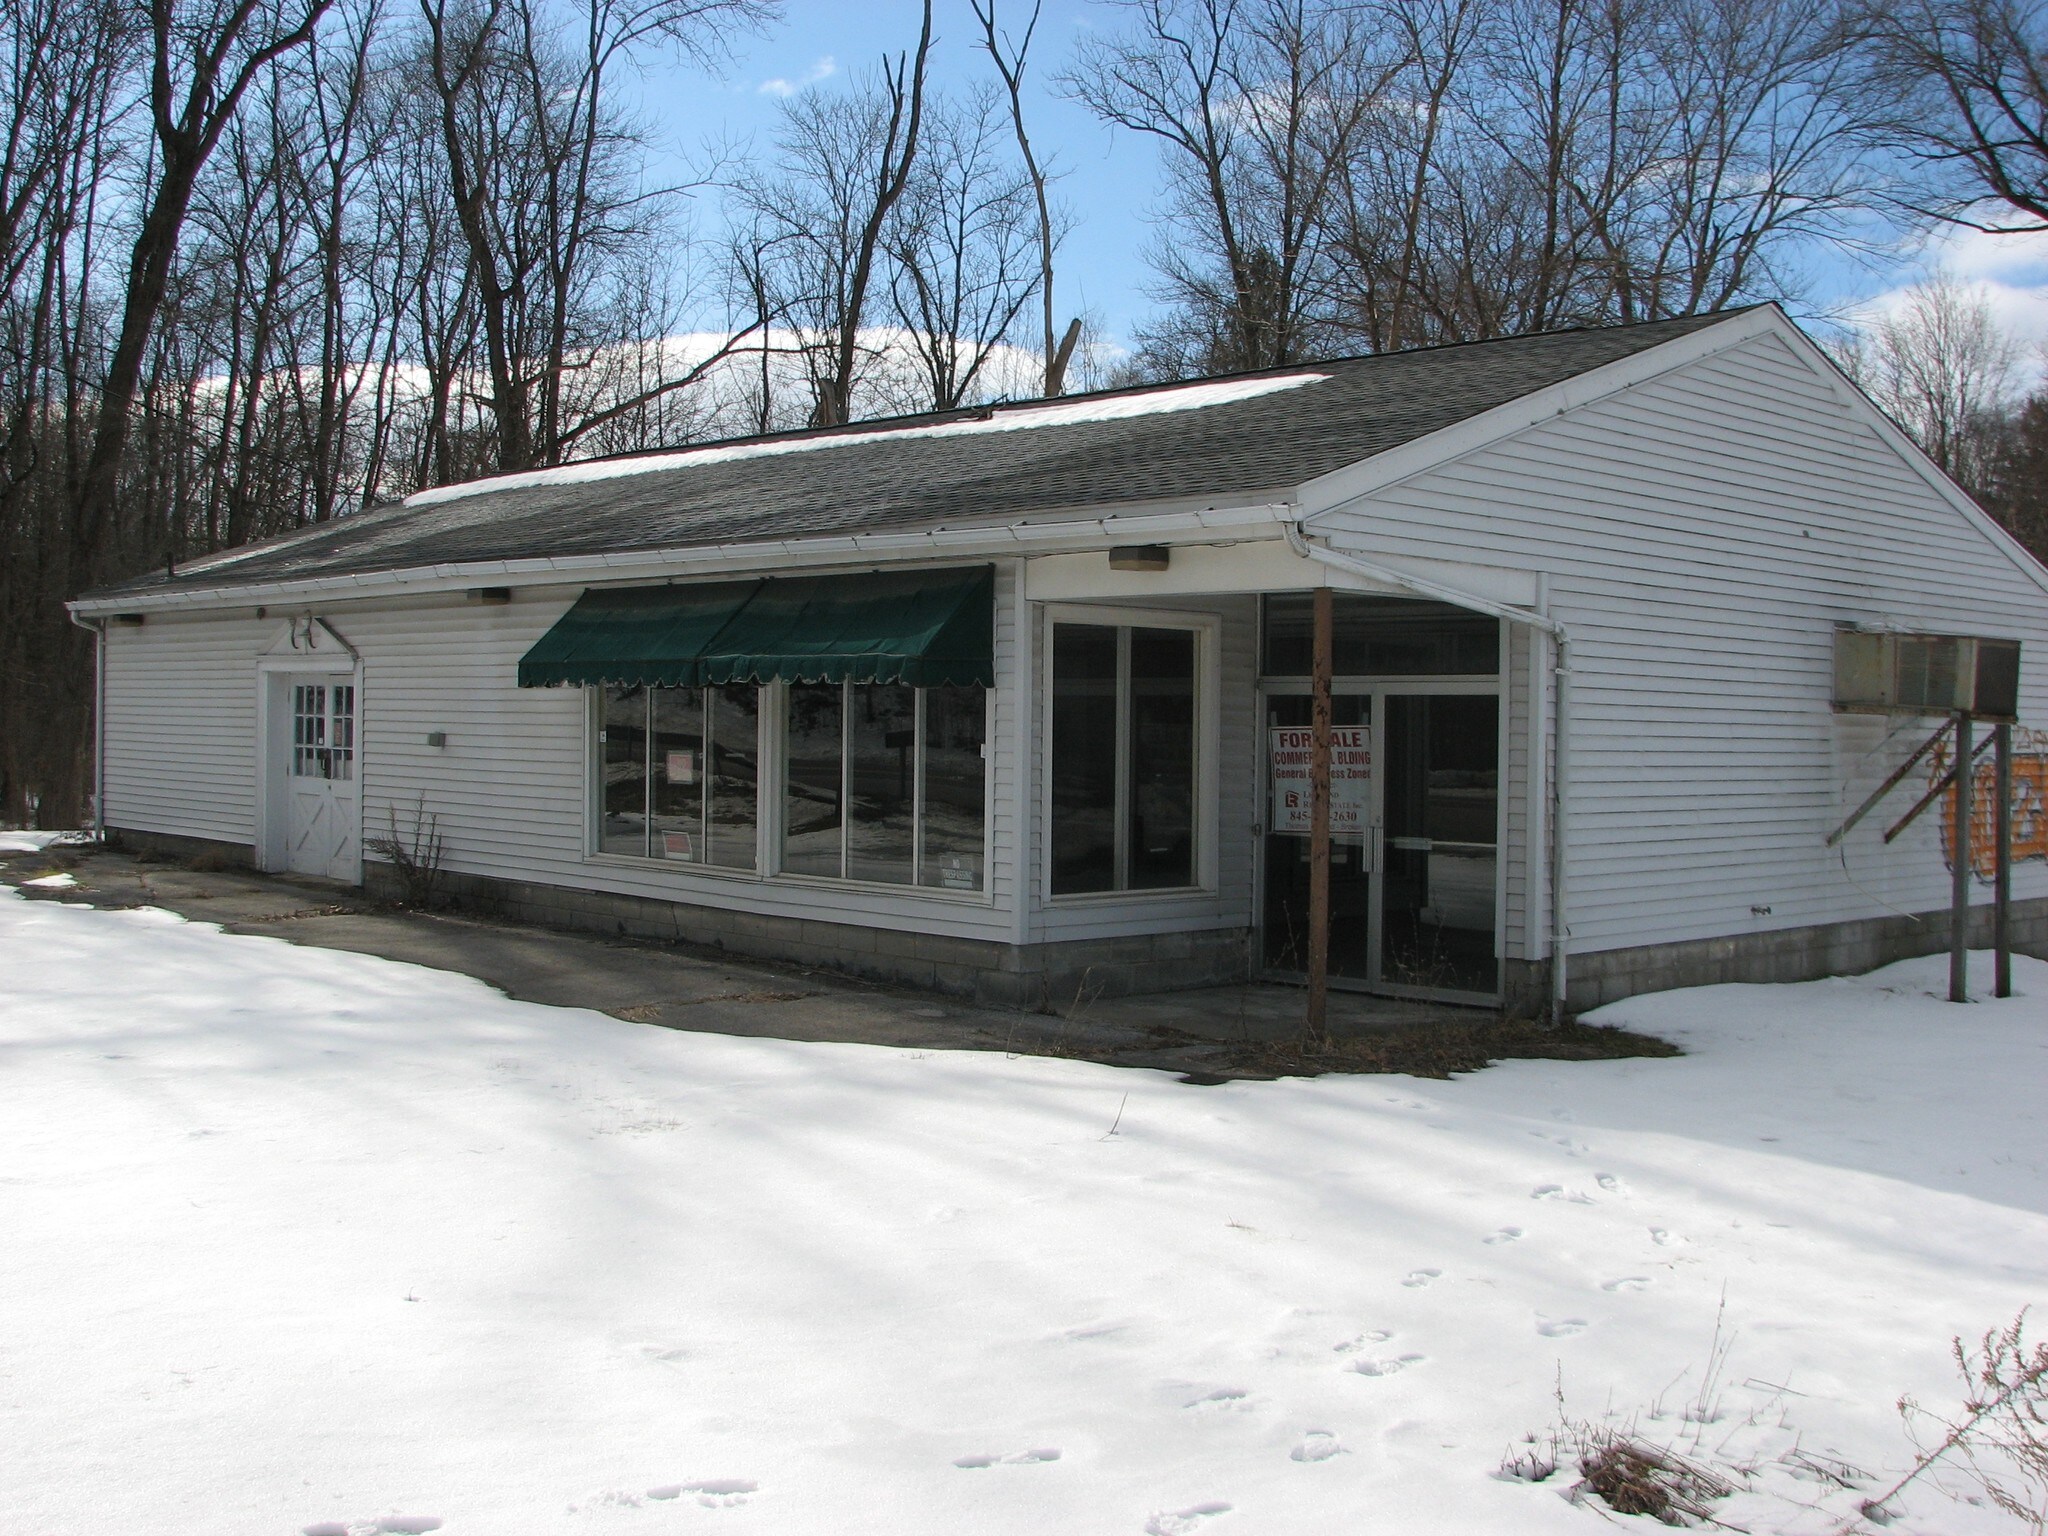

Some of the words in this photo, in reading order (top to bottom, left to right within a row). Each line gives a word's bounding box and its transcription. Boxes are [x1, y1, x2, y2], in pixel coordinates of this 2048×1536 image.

[1279, 732, 1312, 748] FOR
[1329, 732, 1362, 748] ALE
[1275, 768, 1306, 779] General
[1290, 811, 1357, 821] 845--2630
